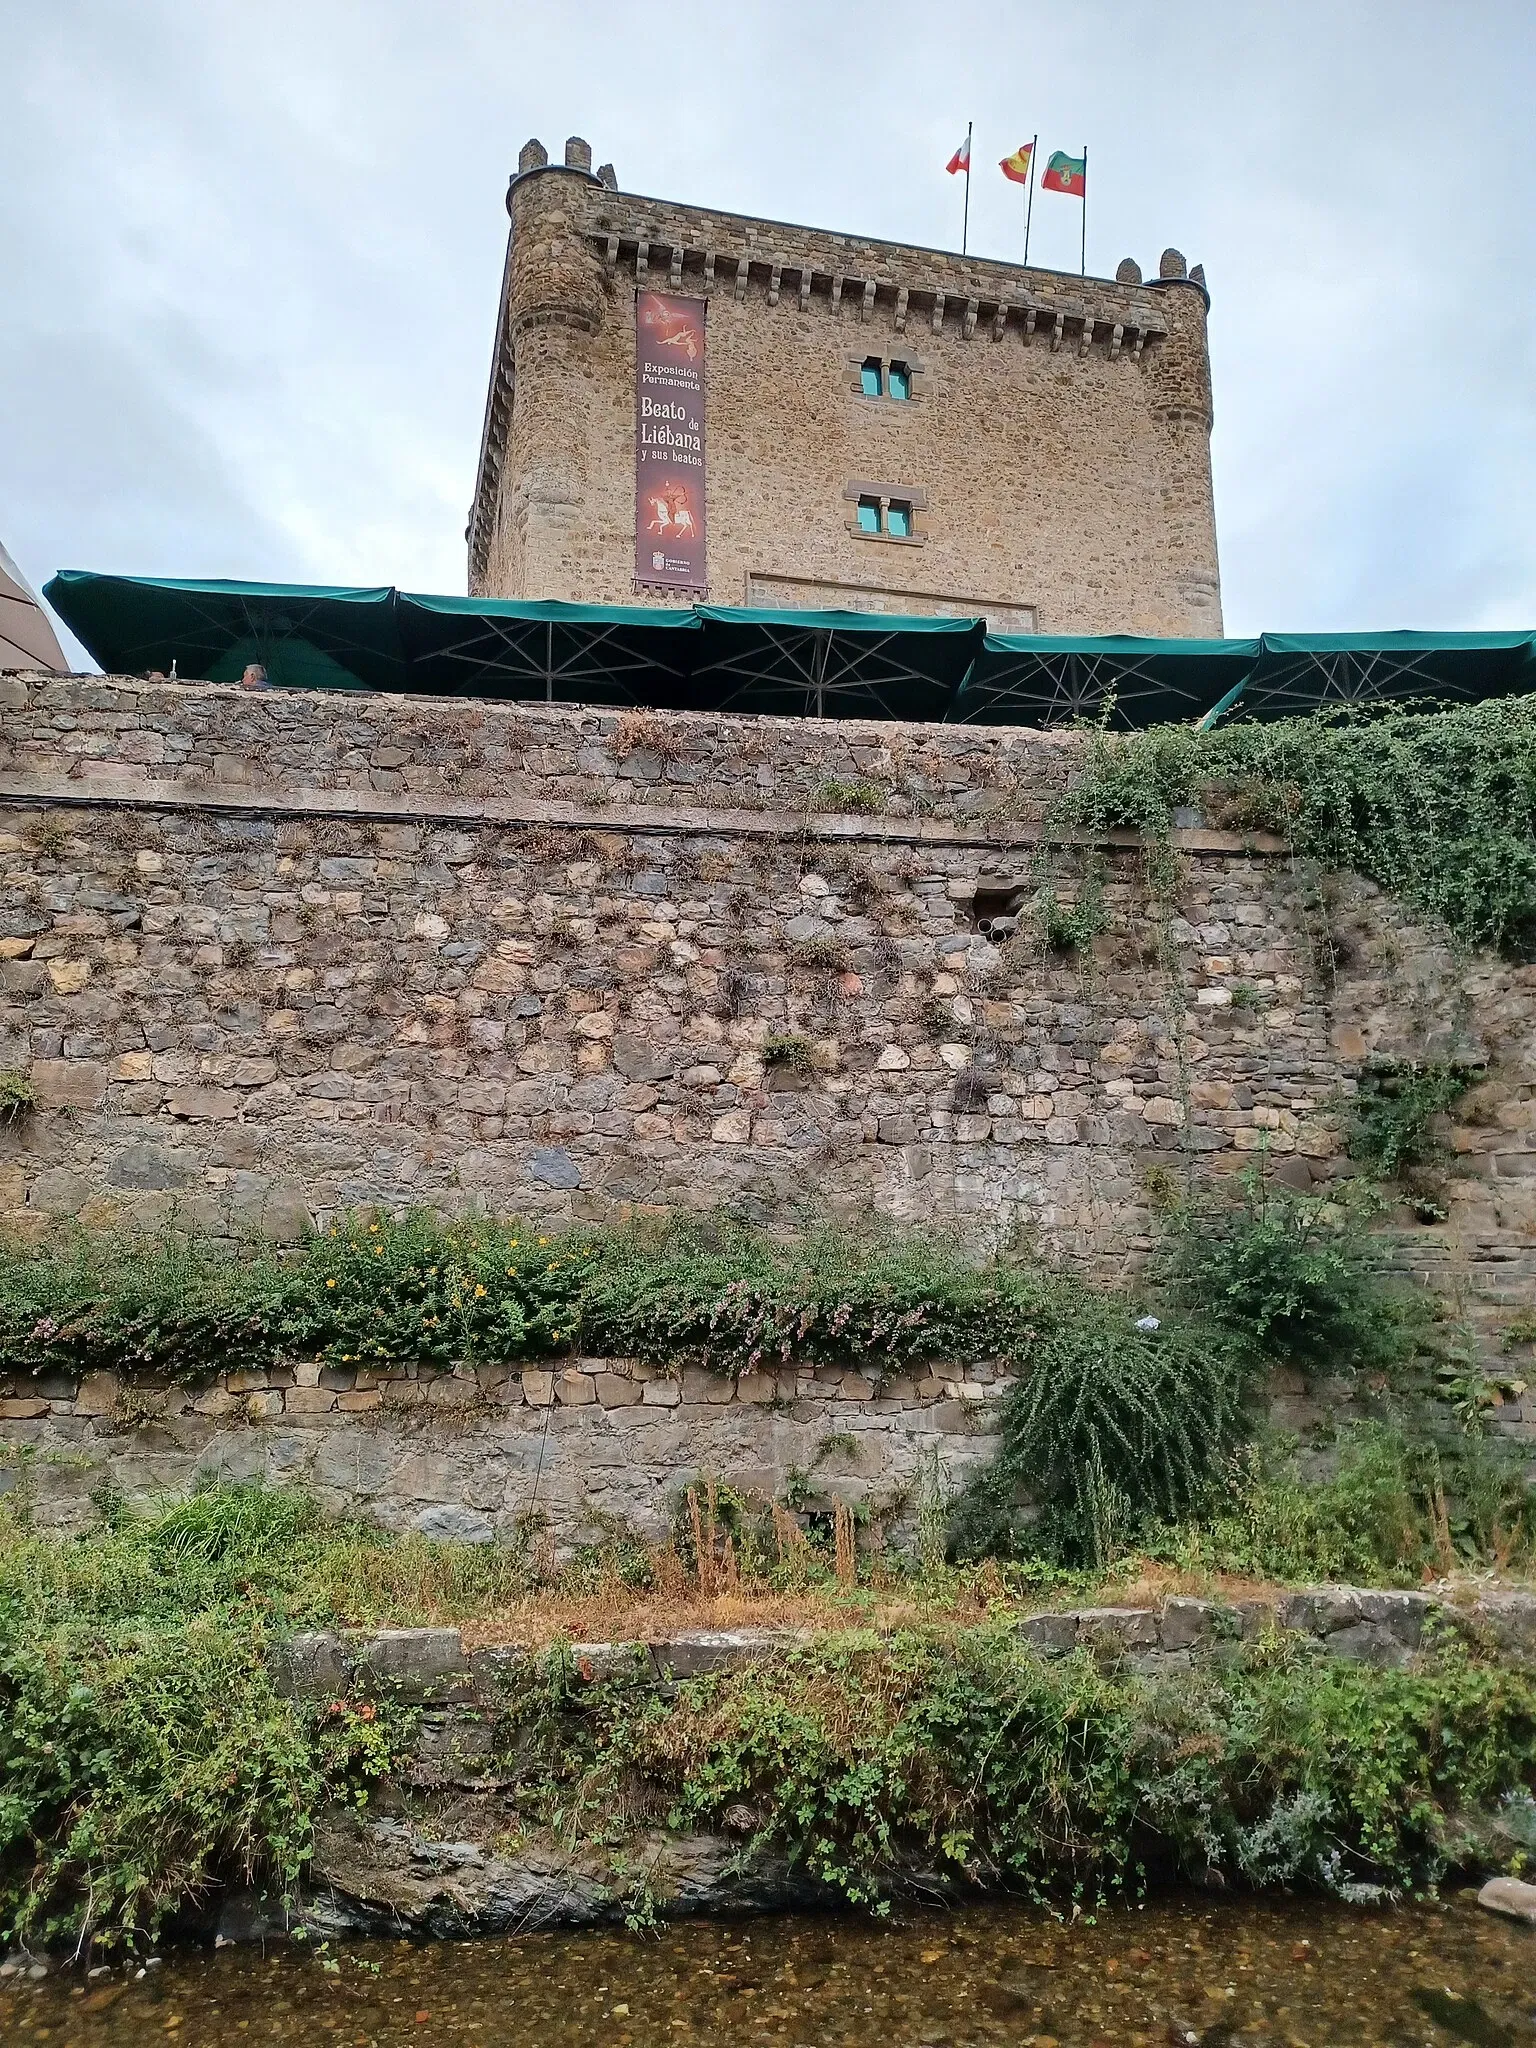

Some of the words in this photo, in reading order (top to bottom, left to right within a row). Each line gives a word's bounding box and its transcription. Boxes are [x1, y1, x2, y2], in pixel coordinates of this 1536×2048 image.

[644, 362, 698, 380] Exposición
[642, 373, 701, 391] Permanente
[641, 396, 686, 421] Beato
[688, 417, 699, 431] de
[641, 423, 701, 451] Liébana
[641, 449, 647, 462] y
[651, 450, 668, 460] sus
[672, 449, 703, 467] beatos
[665, 558, 691, 566] GOBIERNO
